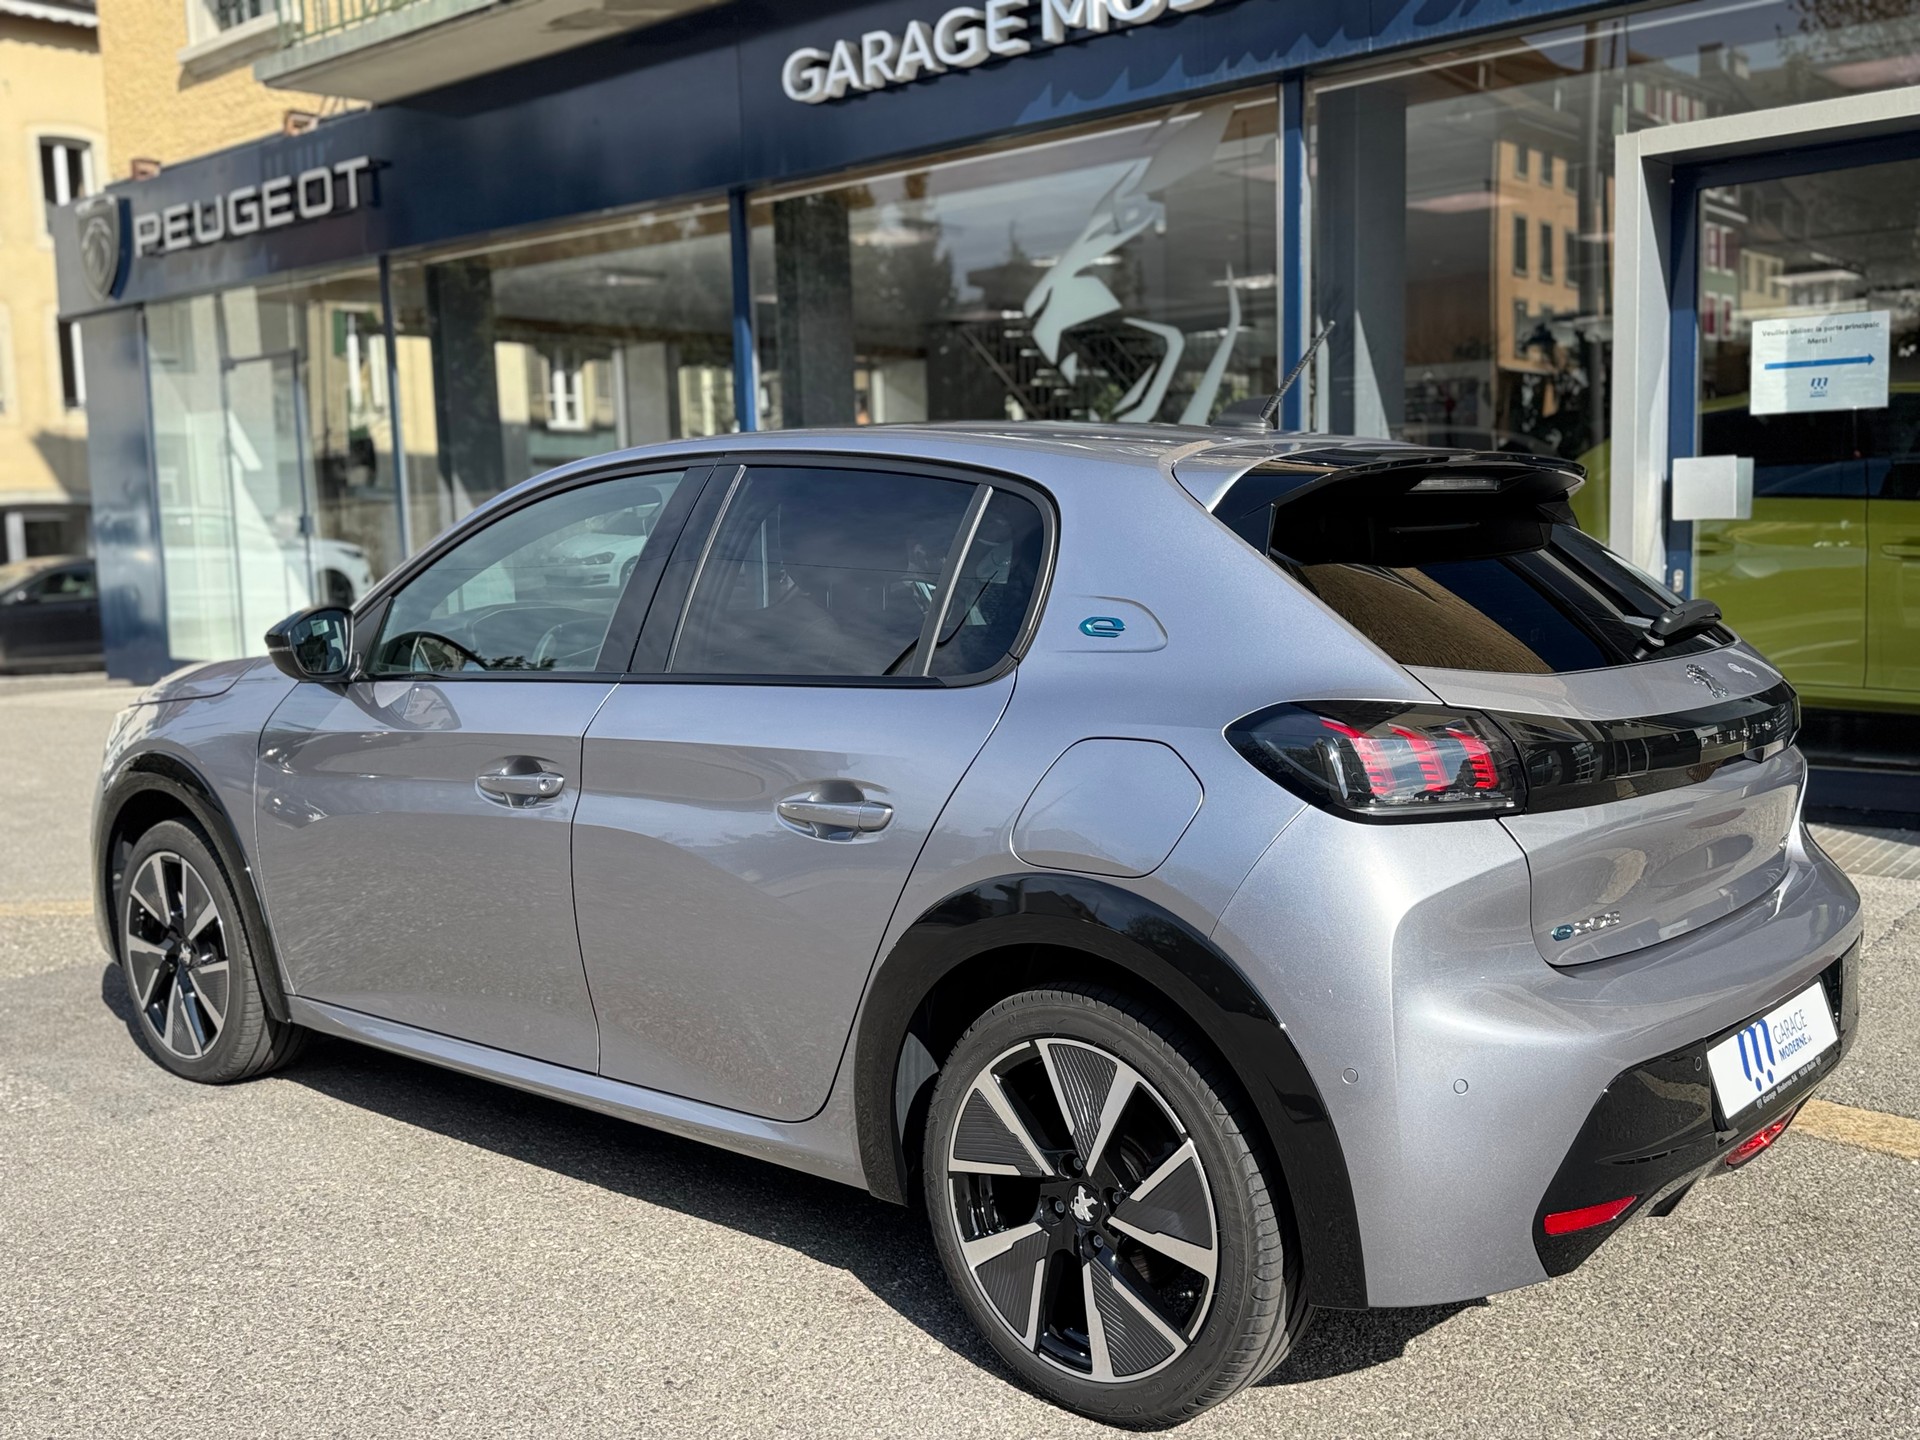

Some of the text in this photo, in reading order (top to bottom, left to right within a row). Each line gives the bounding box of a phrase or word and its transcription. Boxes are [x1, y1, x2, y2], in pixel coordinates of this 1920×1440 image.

[782, 0, 1030, 103] GARAGE
[133, 156, 369, 258] PEUGEOT
[1807, 337, 1828, 345] Merci
[1701, 718, 1779, 747] PEUGEOT
[1773, 1009, 1808, 1045] GARAGE
[1778, 1033, 1808, 1062] MODERNE
[1762, 1090, 1777, 1104] Garage
